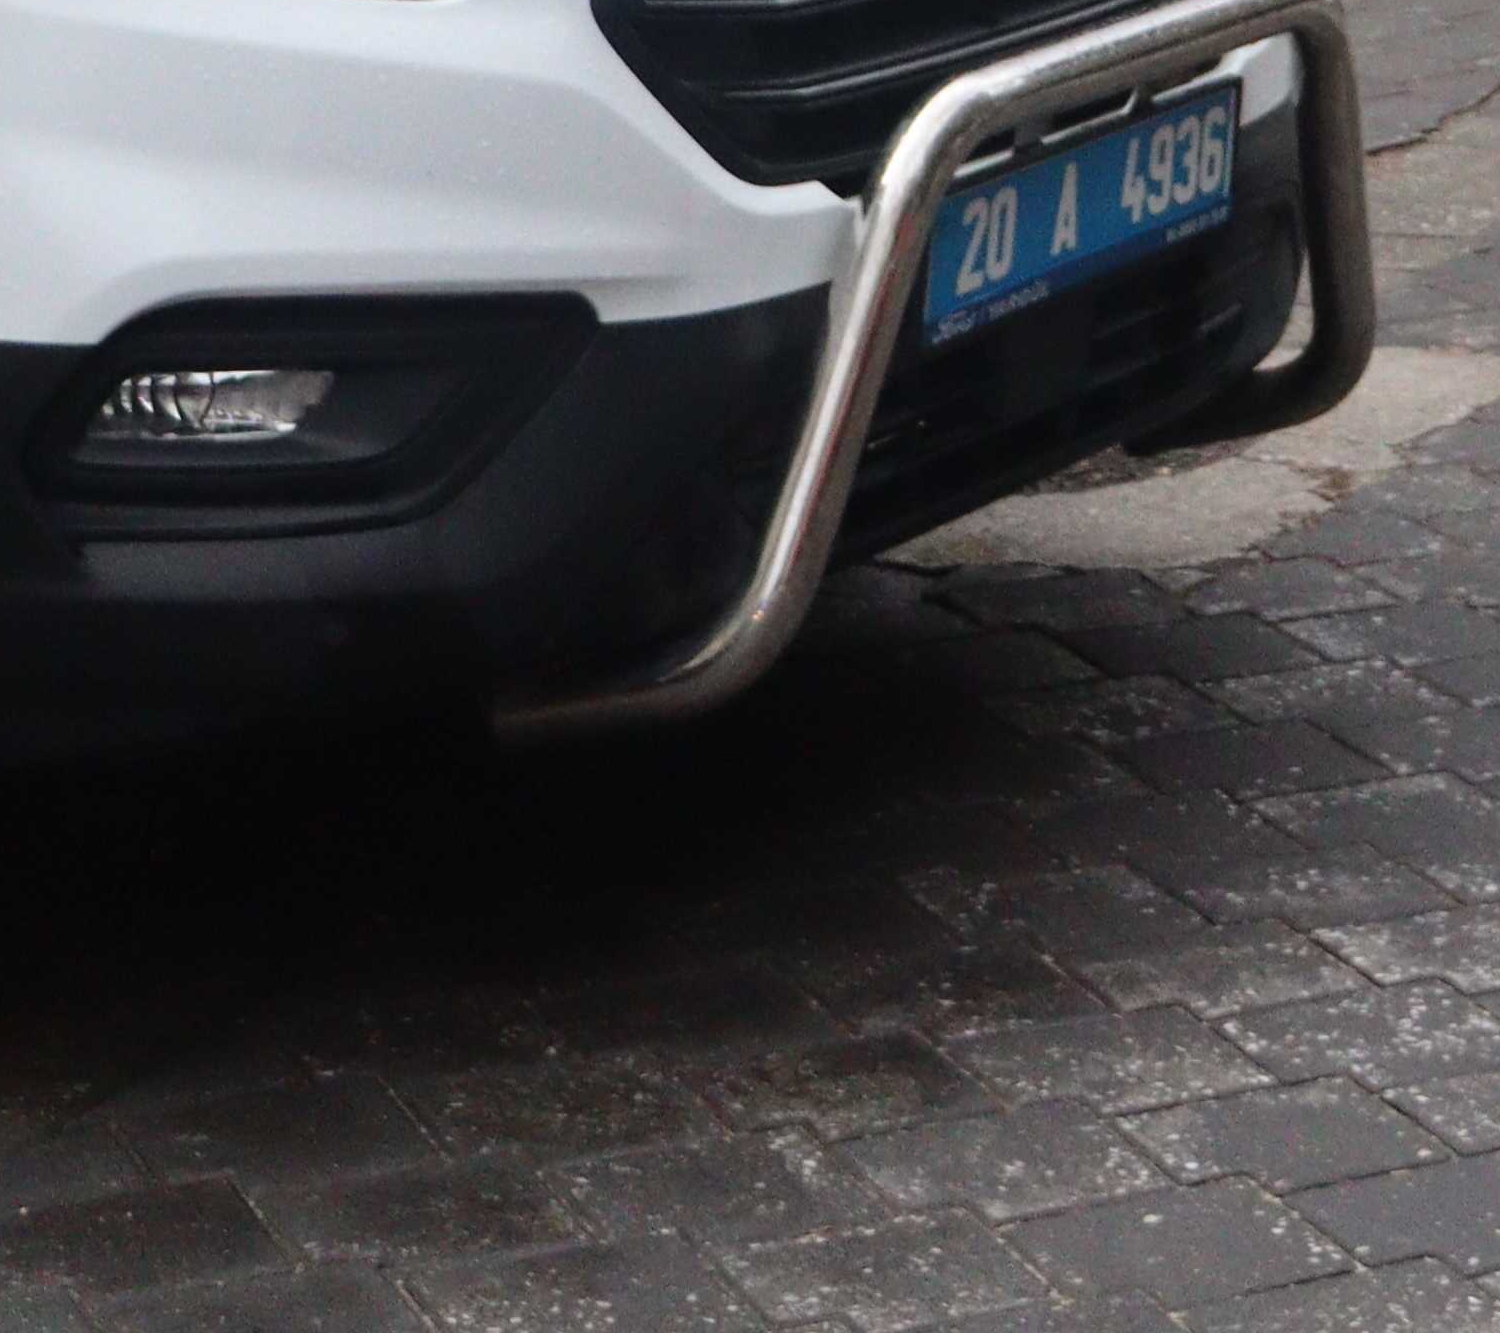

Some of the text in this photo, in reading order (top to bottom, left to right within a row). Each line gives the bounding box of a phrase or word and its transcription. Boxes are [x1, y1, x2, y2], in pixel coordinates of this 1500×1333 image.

[955, 105, 1226, 296] 20 A 4936
